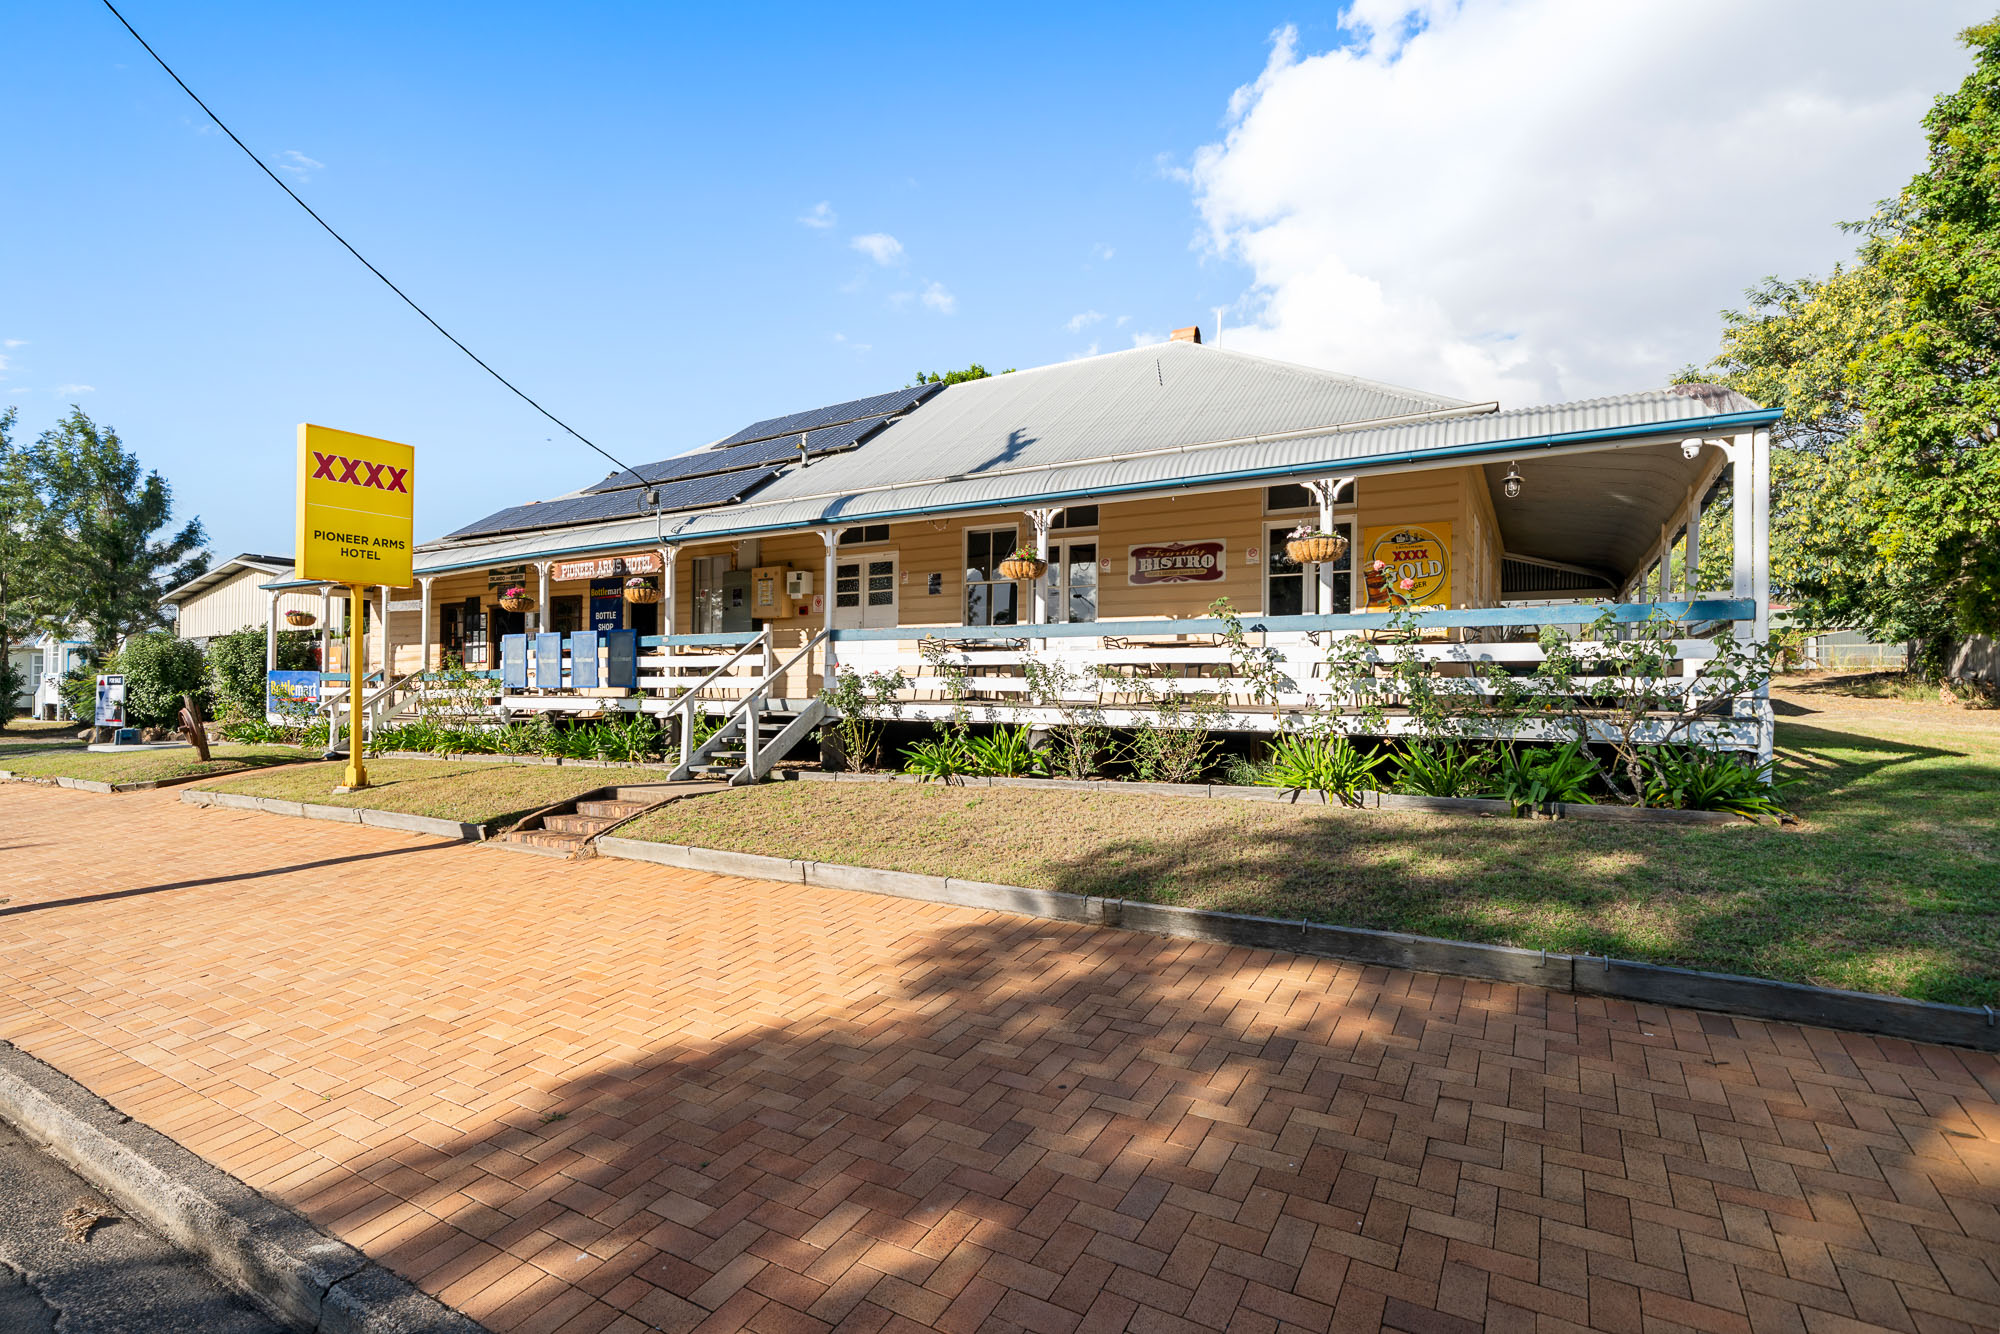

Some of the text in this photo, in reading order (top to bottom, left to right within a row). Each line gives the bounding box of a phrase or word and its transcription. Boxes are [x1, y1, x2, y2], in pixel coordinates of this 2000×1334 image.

[312, 451, 408, 494] XXXX
[314, 530, 405, 549] PIONEER ARMS
[340, 547, 381, 560] HOTEL
[1146, 547, 1206, 557] Family
[1392, 549, 1429, 562] XXXX
[561, 556, 652, 578] PIONEER ARMS HOTEL
[1138, 554, 1215, 572] BISTRO
[1384, 560, 1443, 583] GOLD
[591, 587, 622, 597] Bottlemart
[595, 611, 617, 620] BOTTLE
[597, 623, 614, 631] SHOP
[270, 680, 317, 697] Bottlemart
